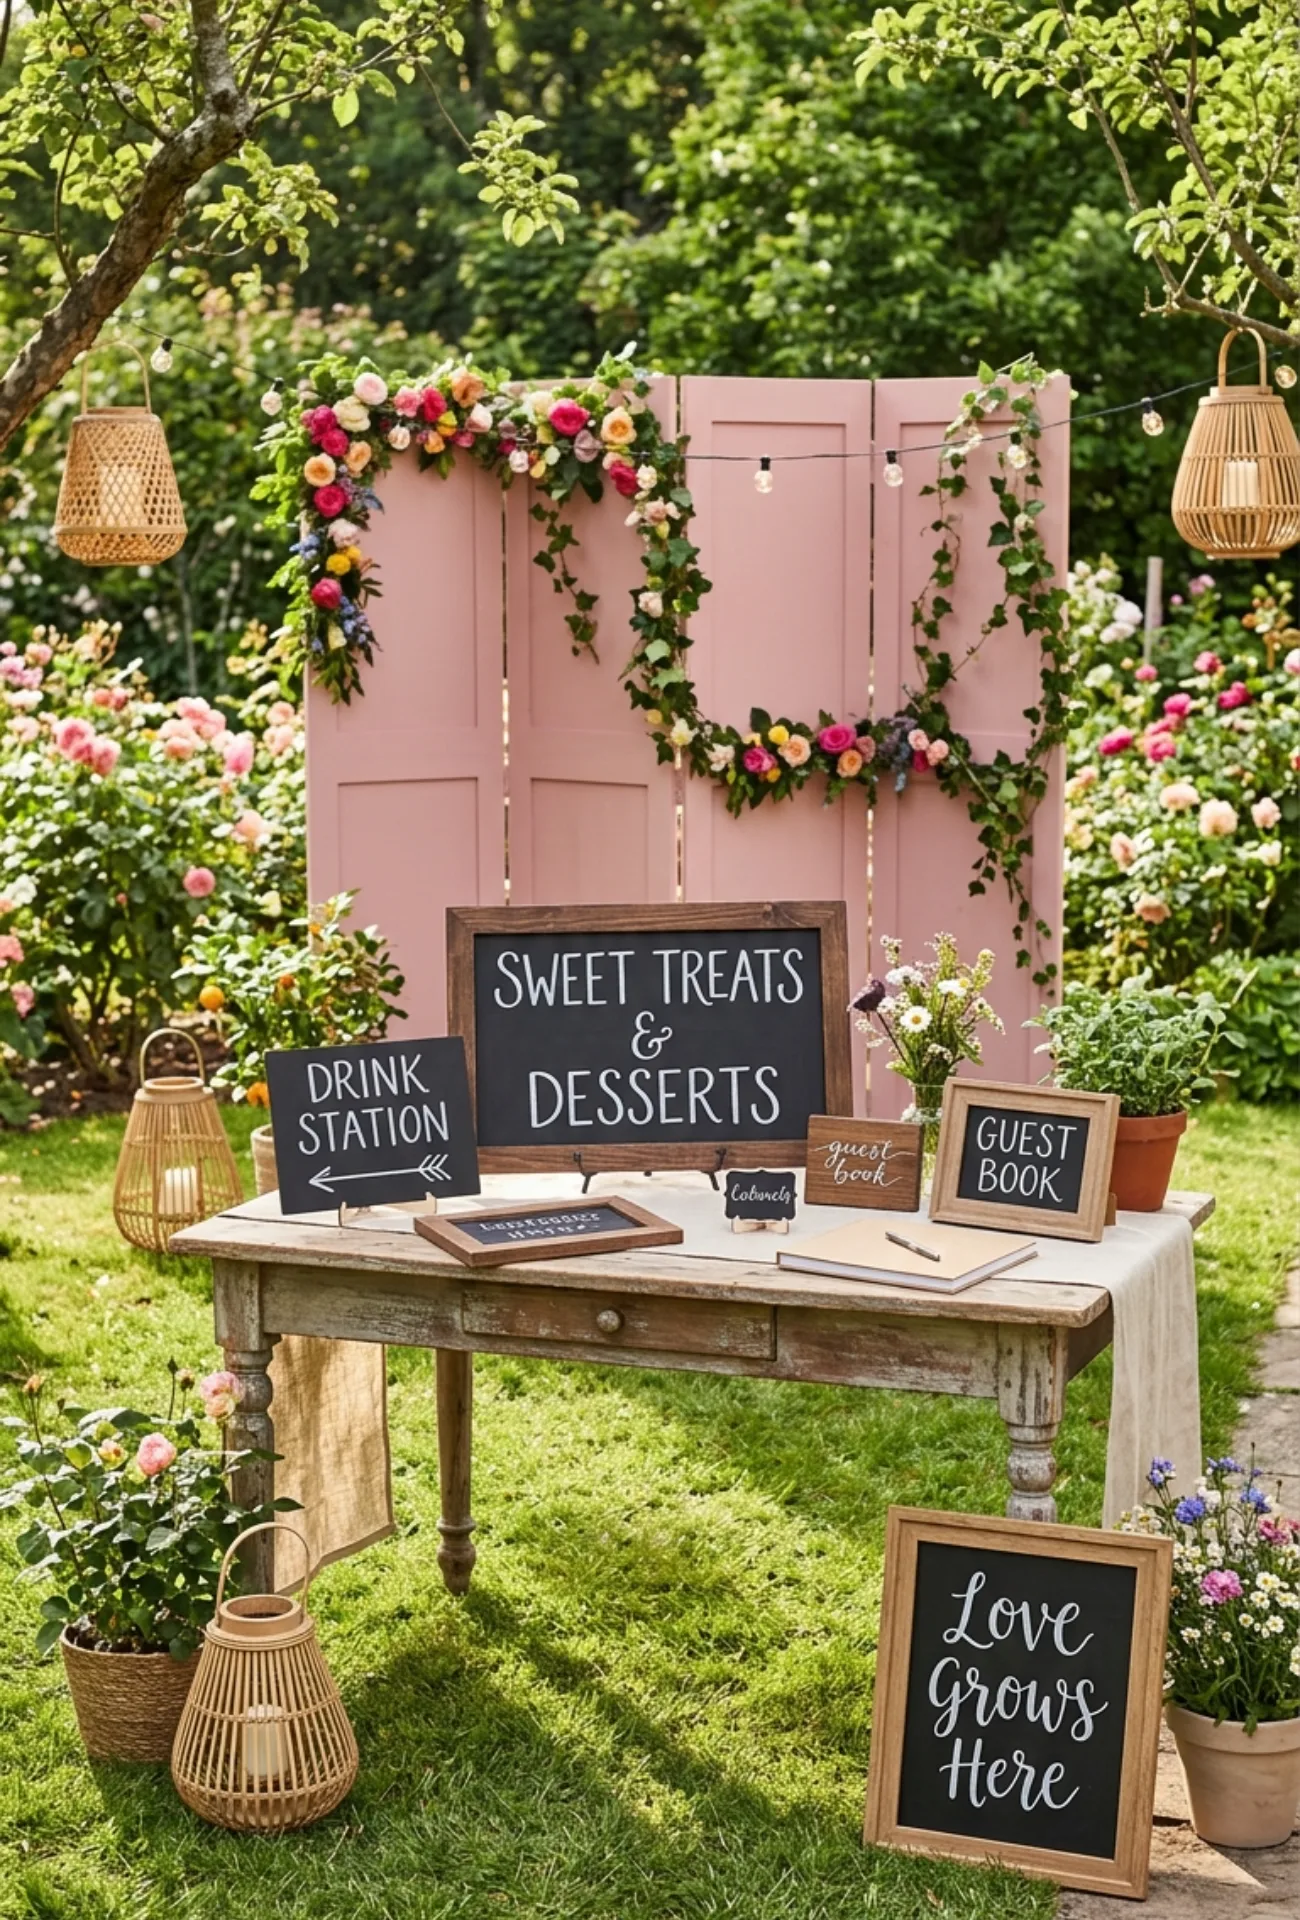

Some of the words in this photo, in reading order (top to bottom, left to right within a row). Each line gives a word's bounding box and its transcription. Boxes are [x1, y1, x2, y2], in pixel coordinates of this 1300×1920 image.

[493, 950, 636, 1008] SWEET
[652, 947, 804, 1006] TREATS
[631, 1010, 673, 1060] &
[307, 1053, 430, 1104] DRINK
[528, 1065, 780, 1129] DESSERTS
[298, 1101, 449, 1156] STATION
[810, 1140, 916, 1169] guest
[976, 1115, 1078, 1160] GUEST
[834, 1158, 903, 1188] book
[977, 1157, 1063, 1203] BOOK
[942, 1571, 1095, 1656] Love
[928, 1656, 1109, 1742] Grows
[939, 1737, 1080, 1811] Here
